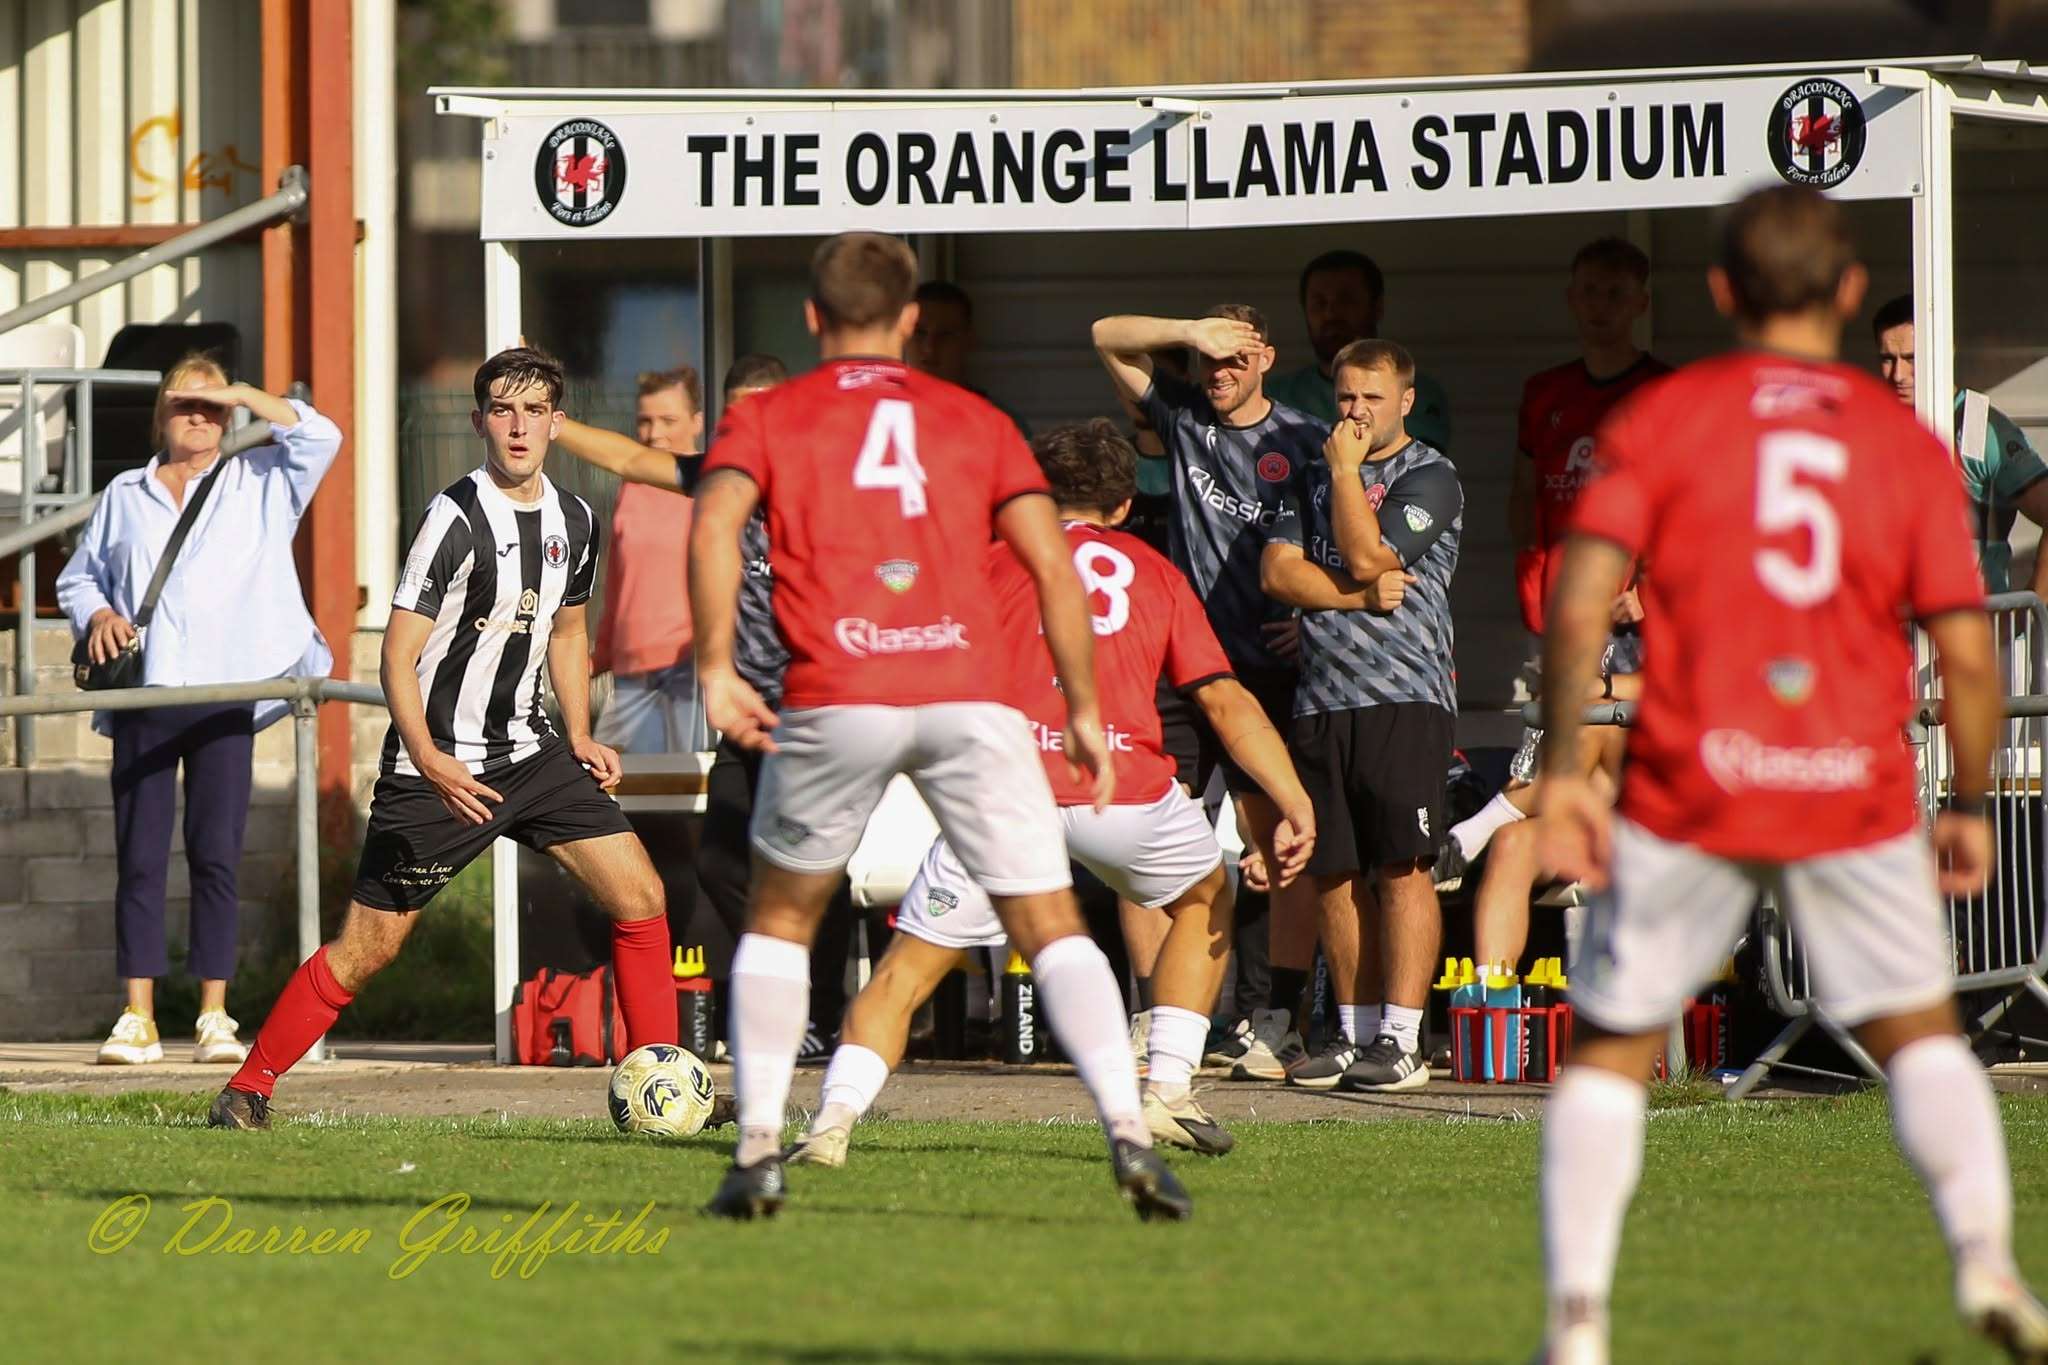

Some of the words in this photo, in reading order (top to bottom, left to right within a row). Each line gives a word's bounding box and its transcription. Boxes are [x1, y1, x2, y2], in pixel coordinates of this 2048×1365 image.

[1783, 82, 1852, 109] DRACONIANS
[549, 122, 616, 149] DRACONIANS
[687, 134, 820, 207] THE
[846, 128, 1131, 206] ORANGE
[1154, 119, 1388, 201] LLAMA
[1410, 102, 1727, 191] STADIUM
[1786, 165, 1808, 183] Fors
[1809, 174, 1820, 184] et
[1820, 162, 1851, 184] Talens
[854, 398, 928, 518] 4
[1756, 431, 1849, 608] 5
[429, 862, 454, 874] Lane
[694, 988, 706, 1053] ILAND
[1018, 983, 1034, 1056] ZILAND
